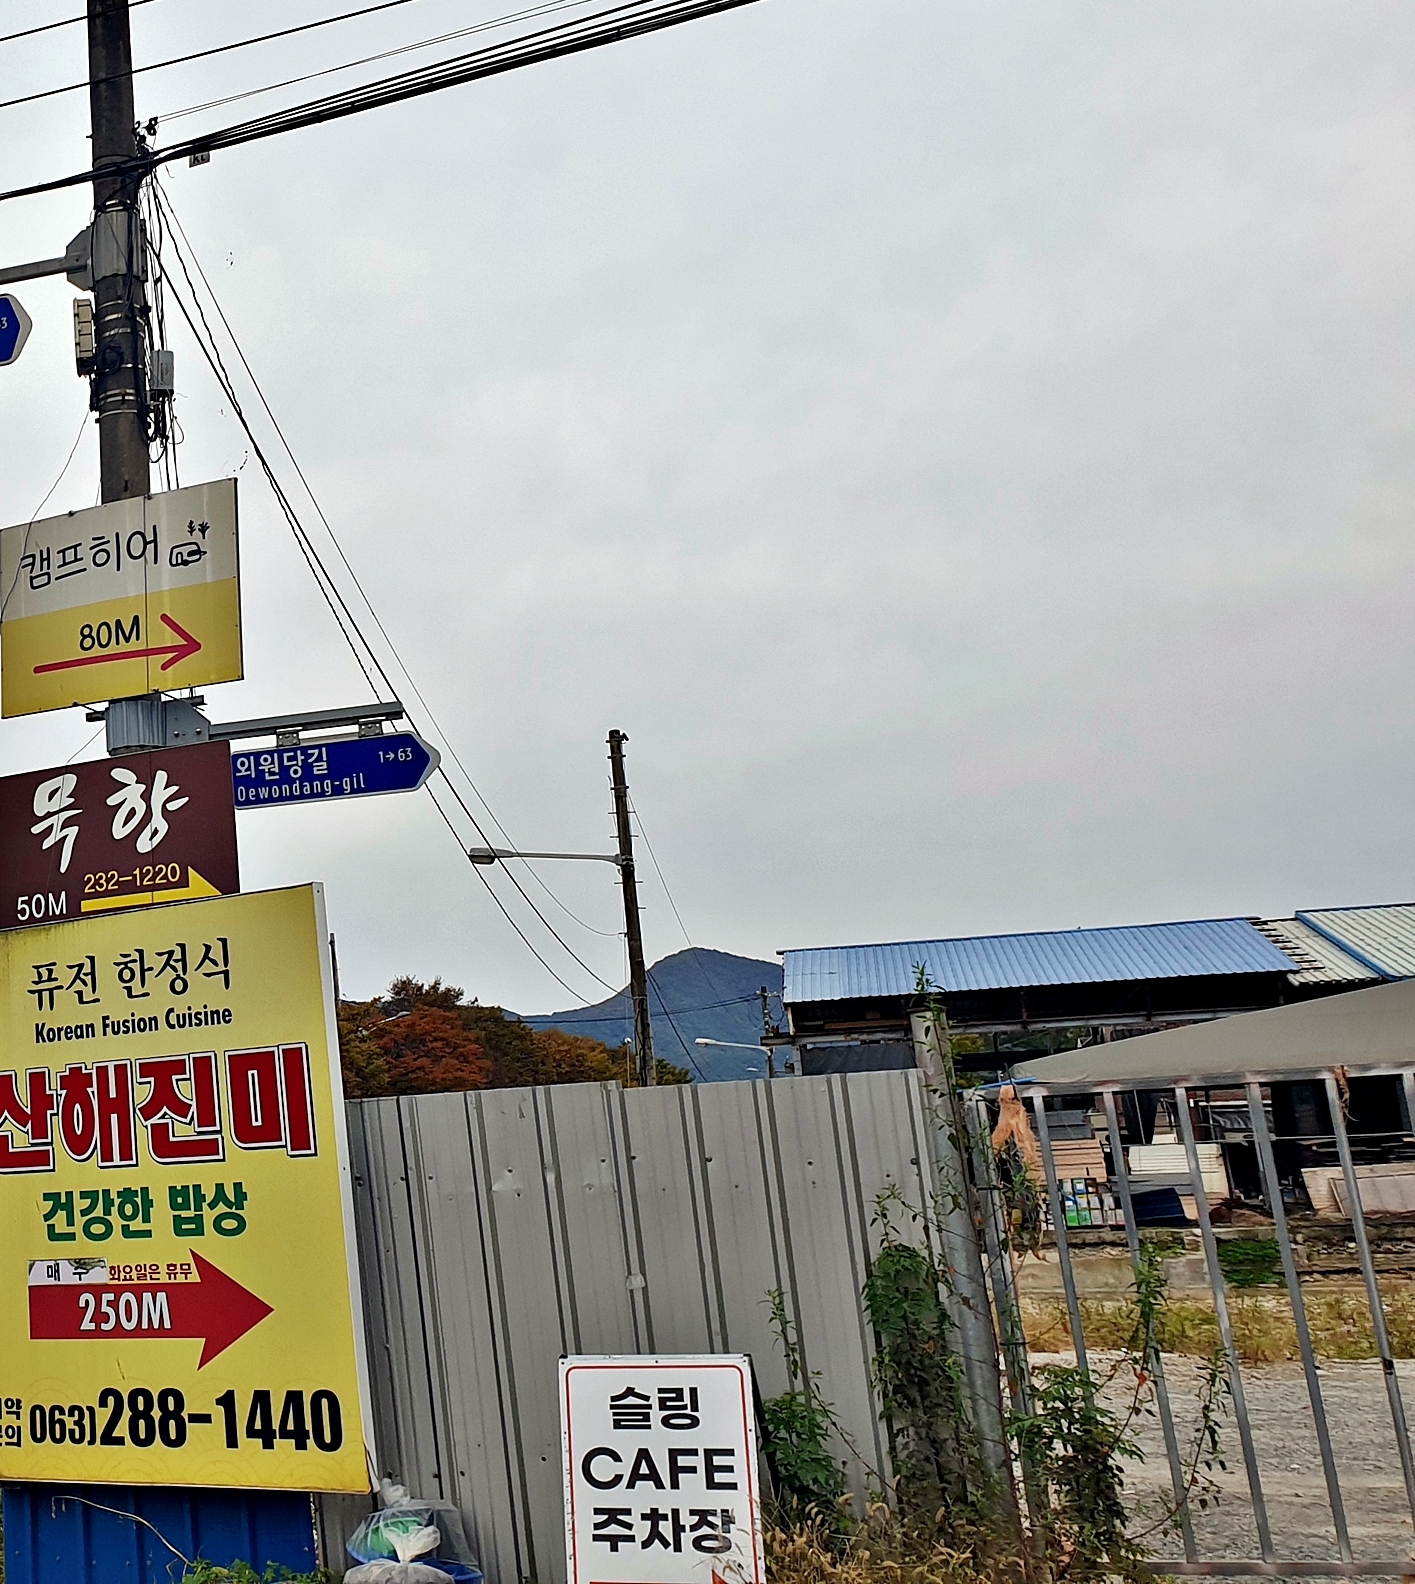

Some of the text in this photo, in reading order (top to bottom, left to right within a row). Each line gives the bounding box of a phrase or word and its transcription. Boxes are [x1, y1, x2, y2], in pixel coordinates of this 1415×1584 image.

[21, 524, 159, 590] 캠프히어
[79, 614, 141, 651] 80M
[235, 747, 329, 780] 외원당길
[237, 773, 365, 801] Oewondang-gil
[84, 863, 181, 894] 232-1220
[16, 890, 68, 921] 50M
[27, 937, 231, 1011] 퓨전 한정식
[35, 1004, 233, 1043] Korean Fusion Cuisine
[42, 1182, 248, 1242] 건강한 밥상
[109, 1264, 161, 1282] 화요일은
[166, 1263, 192, 1280] 휴무
[79, 1291, 171, 1331] 250M
[609, 1386, 700, 1430] 슬링
[581, 1446, 738, 1490] CAFE
[592, 1507, 736, 1554] 주차장
